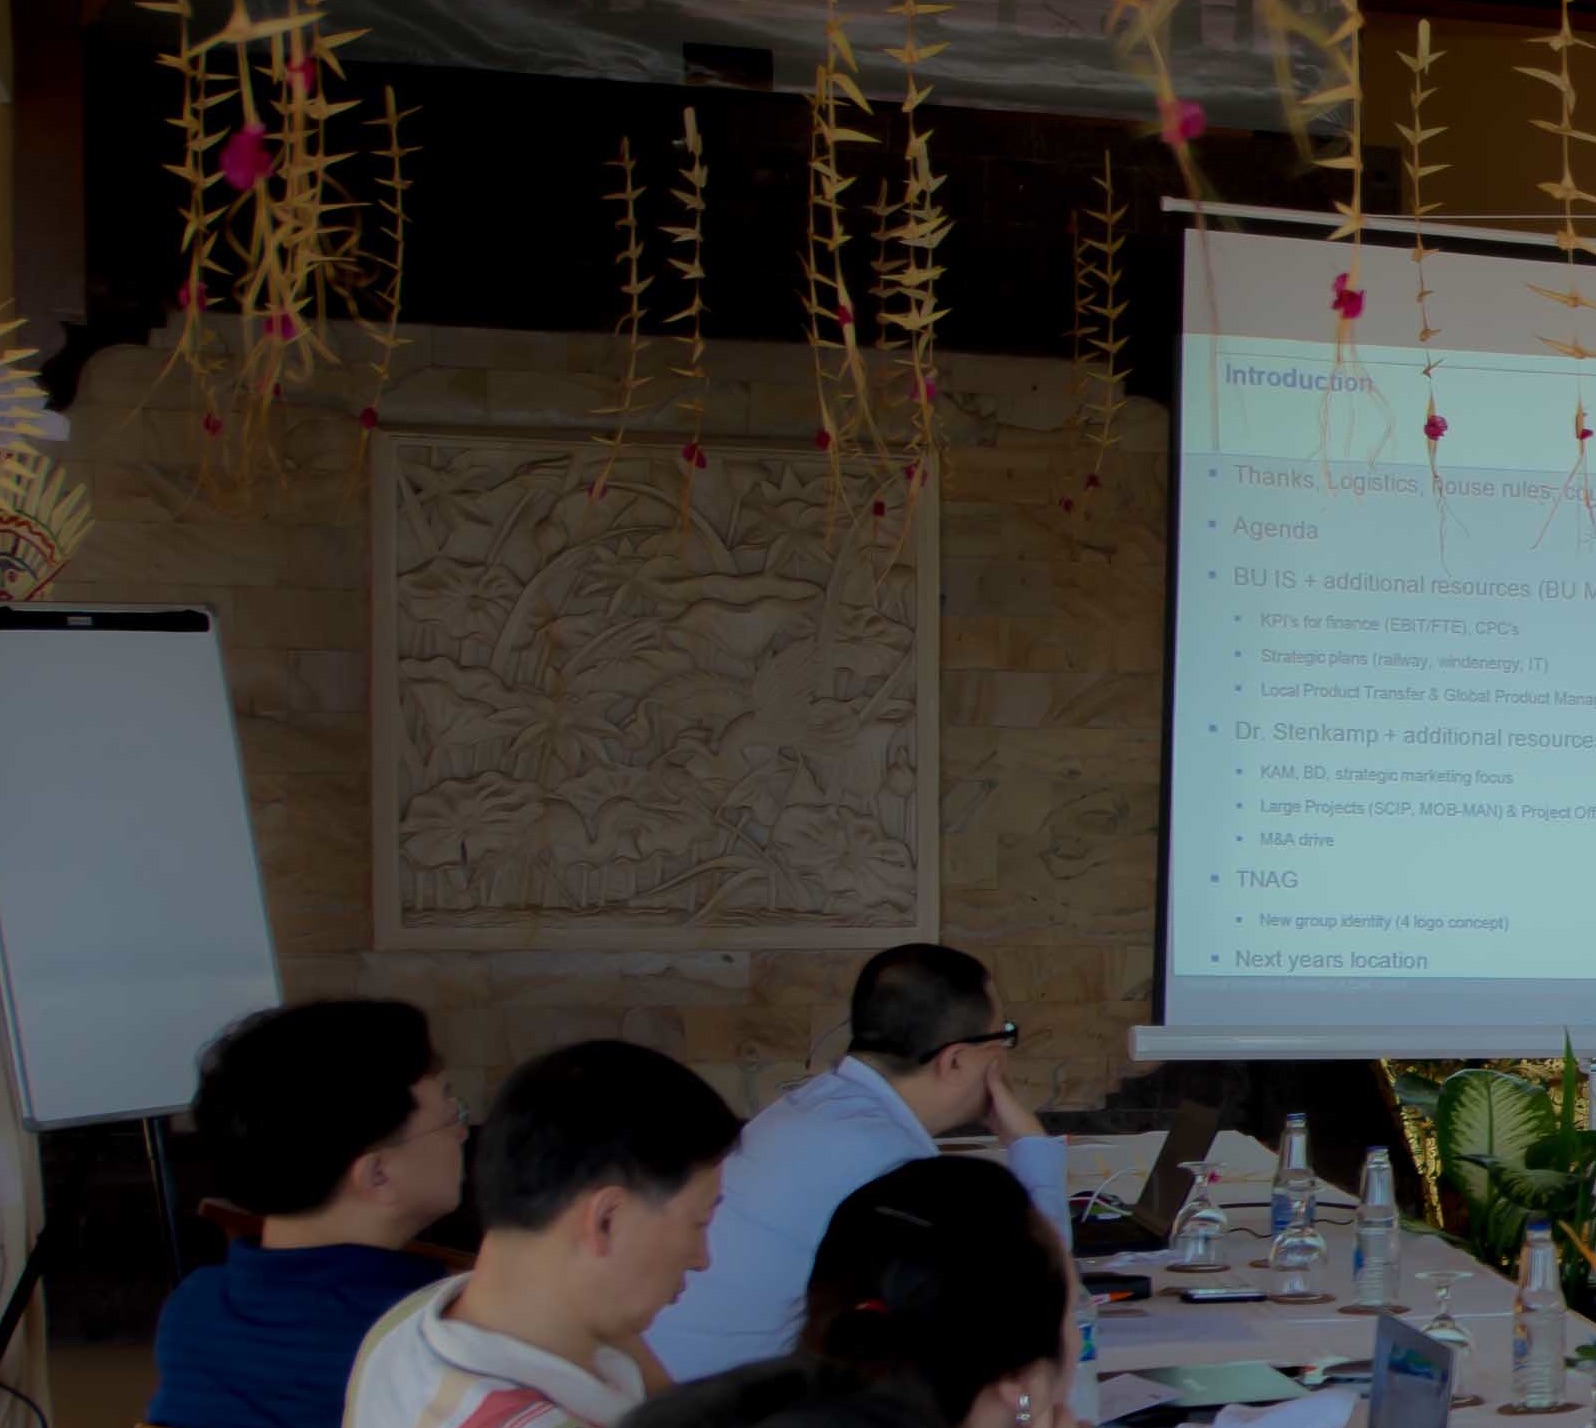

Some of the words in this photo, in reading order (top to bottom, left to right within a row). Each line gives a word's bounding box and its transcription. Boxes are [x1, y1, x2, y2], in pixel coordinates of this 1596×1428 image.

[1225, 363, 1375, 392] Introduction
[1232, 515, 1318, 541] Agenda
[1233, 567, 1268, 588] BU
[1273, 568, 1296, 589] IS
[1324, 572, 1424, 595] additional
[1431, 577, 1529, 598] resources
[1537, 580, 1576, 604] (BU
[1304, 614, 1323, 630] for
[1260, 649, 1325, 668] Strategic
[1328, 651, 1368, 669] plans
[1260, 682, 1299, 699] Local
[1303, 683, 1360, 700] Product
[1365, 684, 1425, 701] Transfer
[1428, 687, 1439, 702] &
[1444, 687, 1490, 703] Global
[1495, 688, 1550, 705] Product
[1273, 722, 1378, 748] Stenkamp
[1403, 727, 1503, 746] additional
[1335, 766, 1398, 784] strategic
[1401, 768, 1471, 787] marketing
[1475, 770, 1513, 785] focus
[1260, 799, 1302, 817] Large
[1306, 800, 1365, 817] Projects
[1507, 805, 1517, 819] &
[1522, 805, 1571, 821] Project
[1299, 833, 1334, 847] drive
[1237, 870, 1298, 888] TNAG
[1260, 914, 1291, 928] New
[1295, 917, 1337, 932] group
[1341, 914, 1391, 932] identity
[1396, 915, 1409, 930] (4
[1414, 916, 1444, 931] logo
[1448, 916, 1509, 932] concept)
[1236, 950, 1282, 969] Next
[1287, 953, 1343, 974] years
[1351, 950, 1428, 969] location
